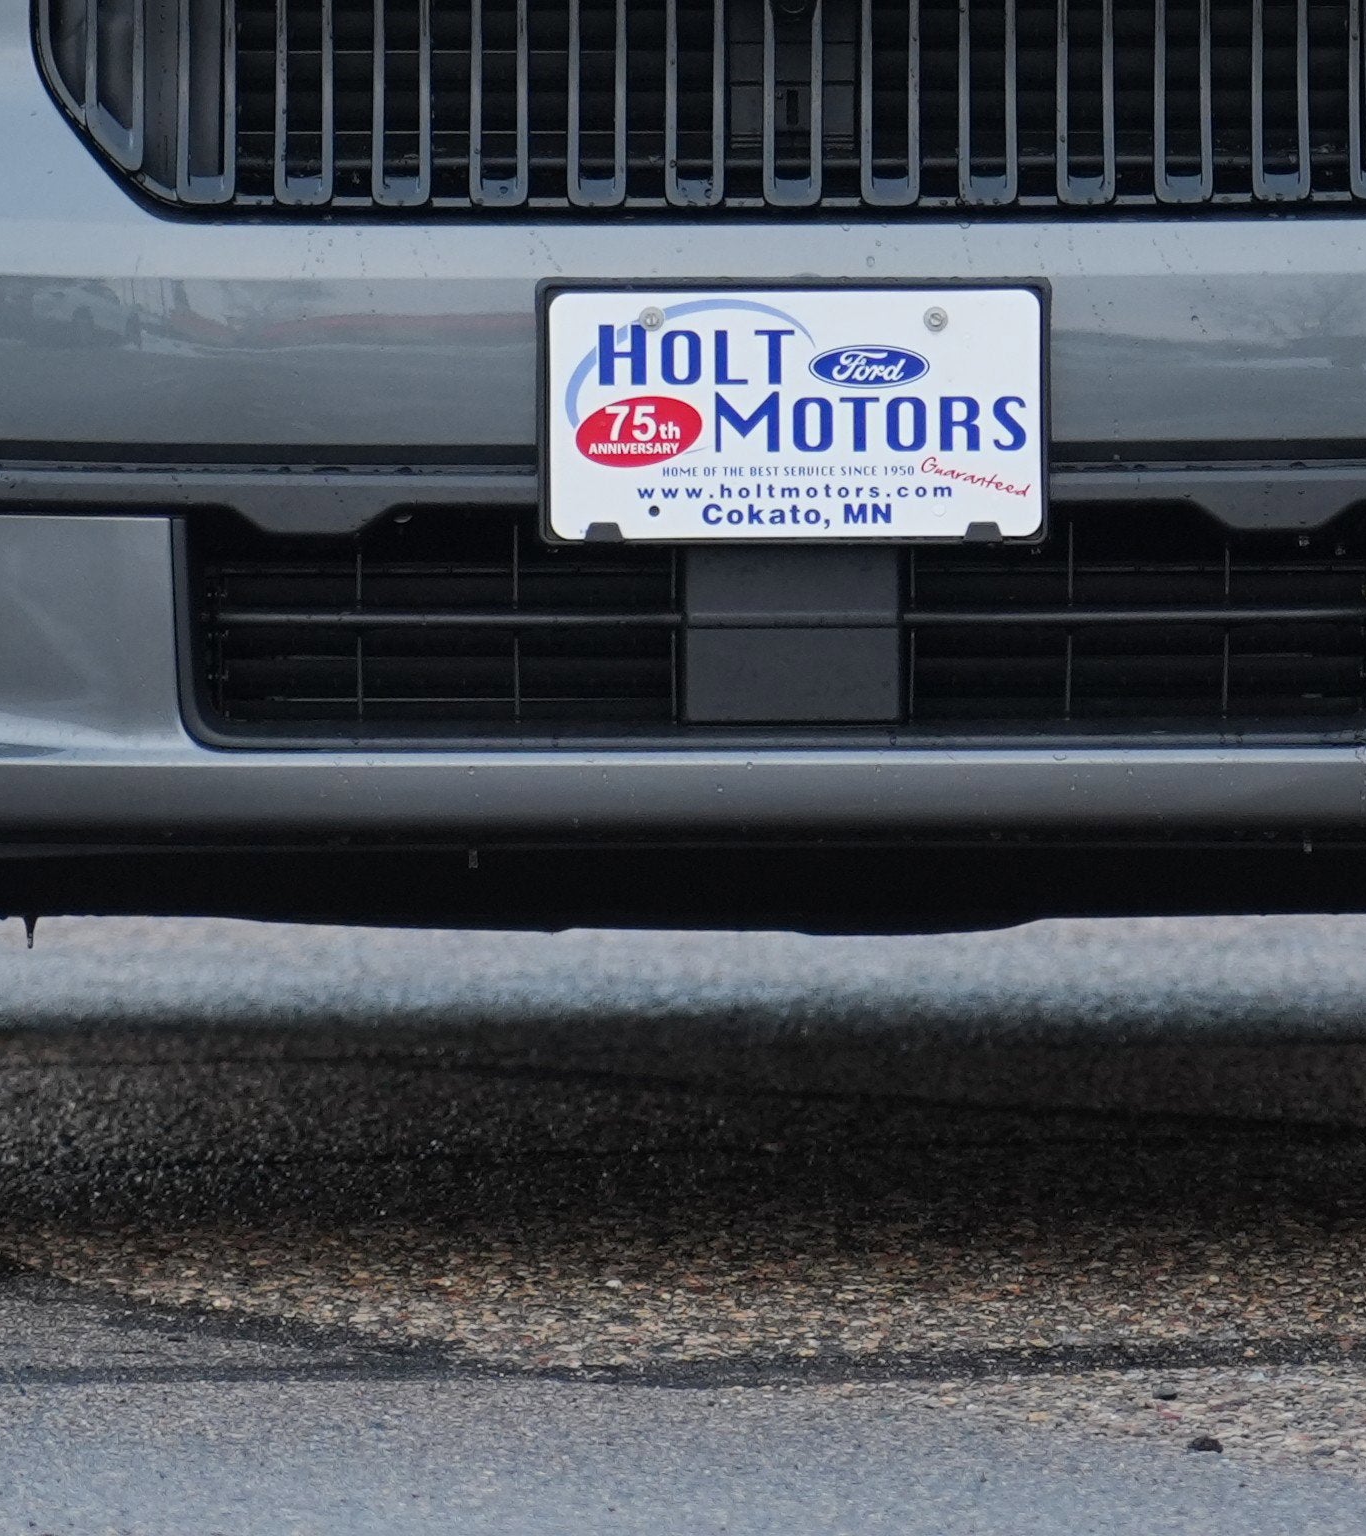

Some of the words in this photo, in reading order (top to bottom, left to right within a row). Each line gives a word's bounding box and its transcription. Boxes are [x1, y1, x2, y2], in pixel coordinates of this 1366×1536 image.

[598, 324, 795, 386] HOLT
[831, 350, 907, 382] Ford
[604, 405, 681, 442] 75th
[714, 390, 1027, 453] MOTORS
[588, 442, 680, 455] ANNIVERSARY
[662, 466, 698, 477] HOME
[703, 466, 719, 477] OF
[723, 466, 744, 477] THE
[749, 466, 779, 477] BEST
[784, 466, 836, 477] SERVICE
[840, 466, 878, 477] SINCE
[883, 466, 915, 476] 1950
[920, 456, 1032, 498] Guaranteed
[637, 484, 953, 499] www.holtmotors.com
[701, 503, 831, 530] Cokato,
[843, 503, 892, 524] MN
